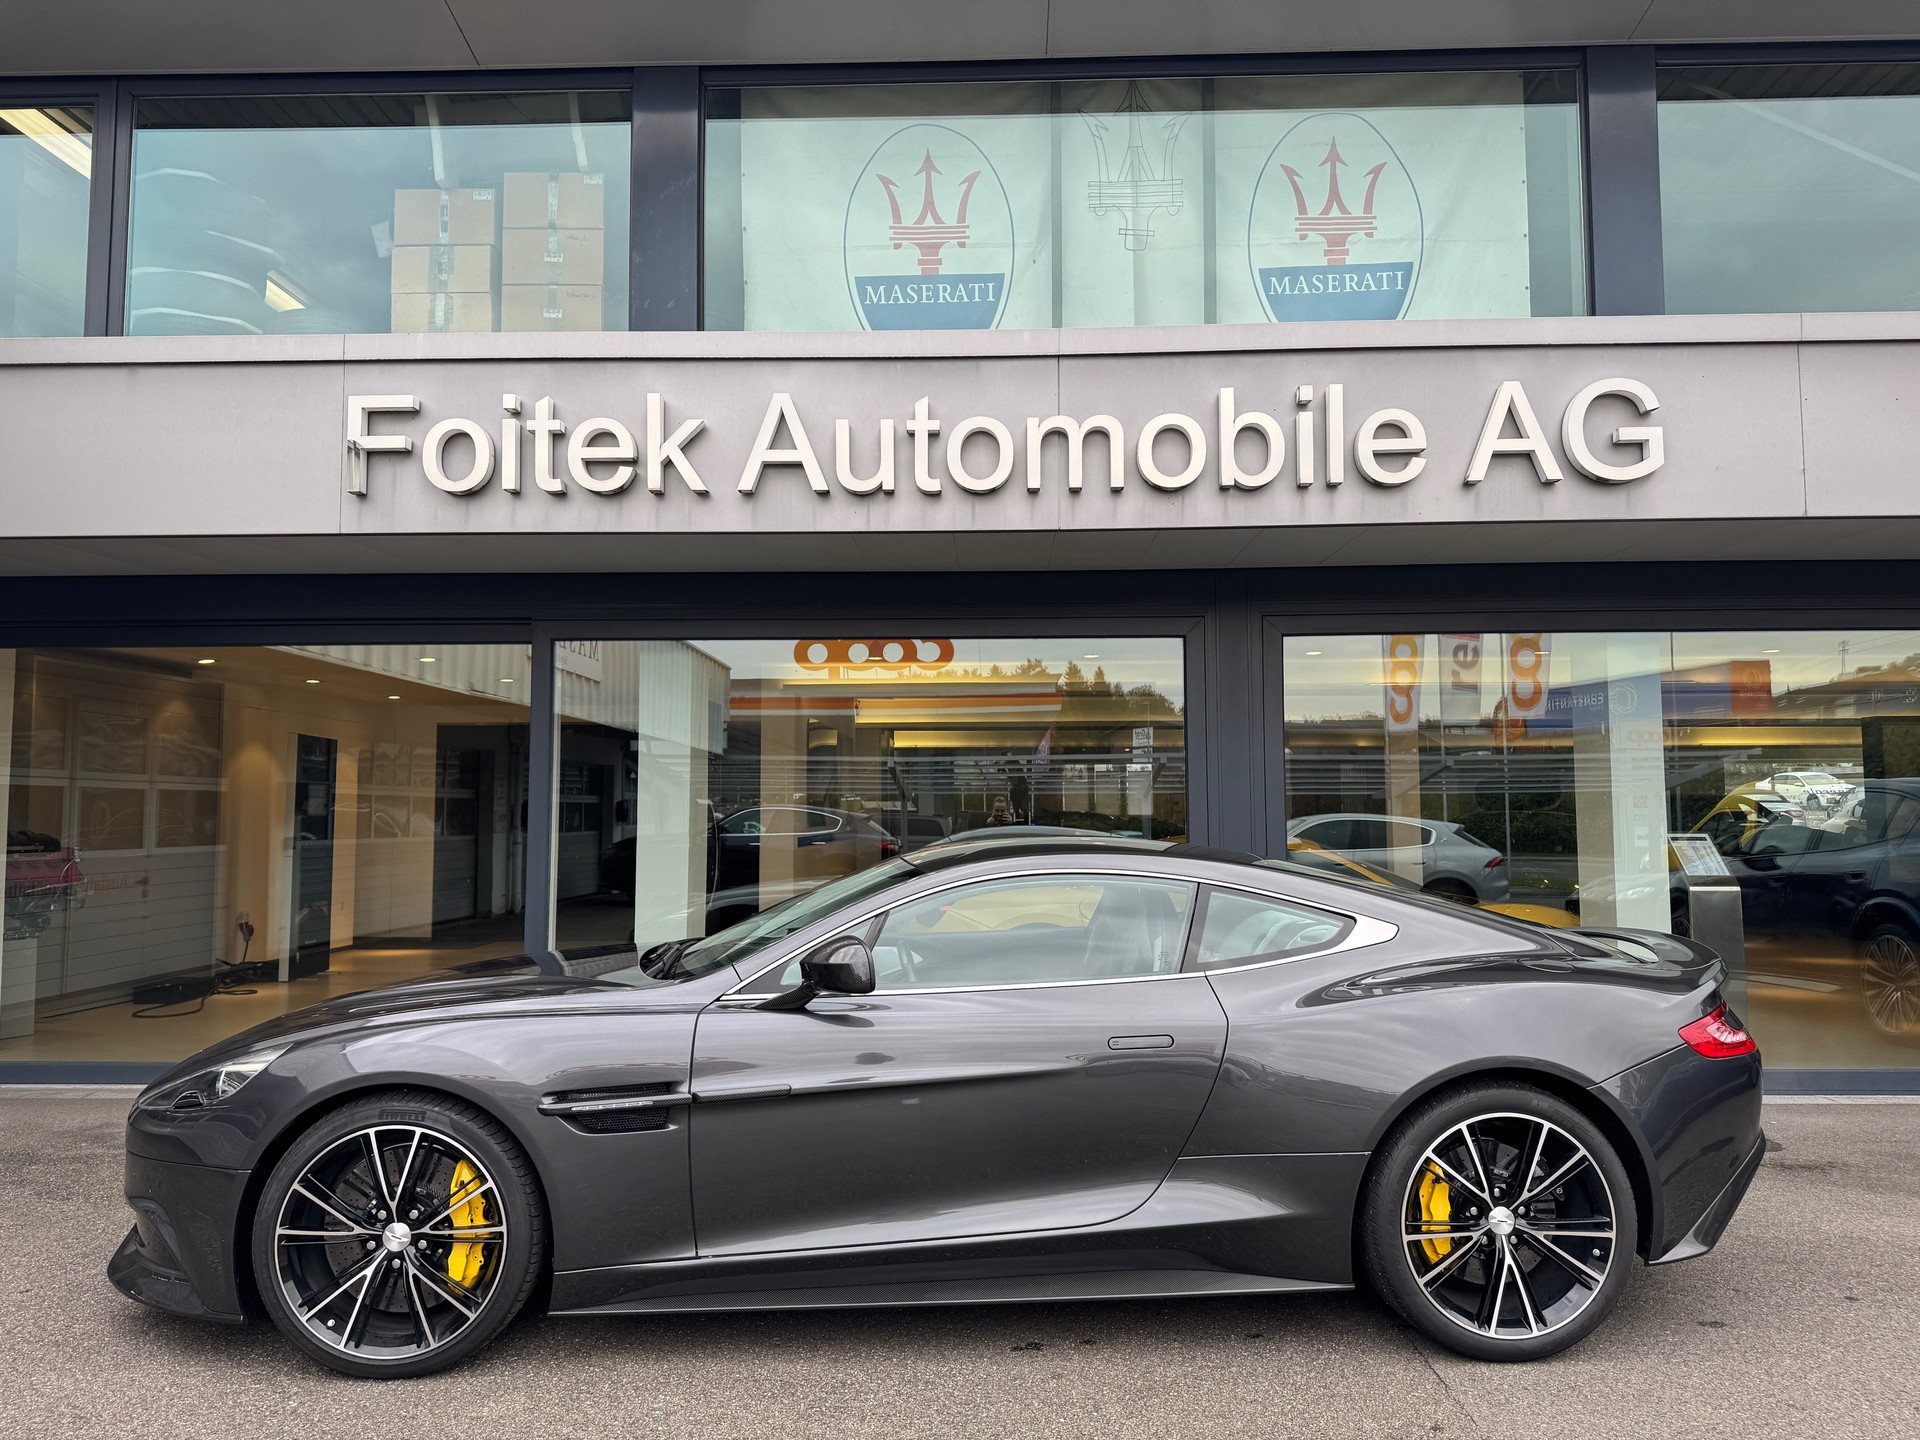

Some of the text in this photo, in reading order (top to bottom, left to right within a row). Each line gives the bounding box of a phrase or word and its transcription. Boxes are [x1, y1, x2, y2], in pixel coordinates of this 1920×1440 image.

[864, 283, 996, 304] MASERATI
[1269, 271, 1404, 295] MASERATI
[347, 377, 1665, 496] Foitek Automobile AG
[1390, 635, 1418, 724] coo
[377, 1108, 427, 1122] PIRELLI
